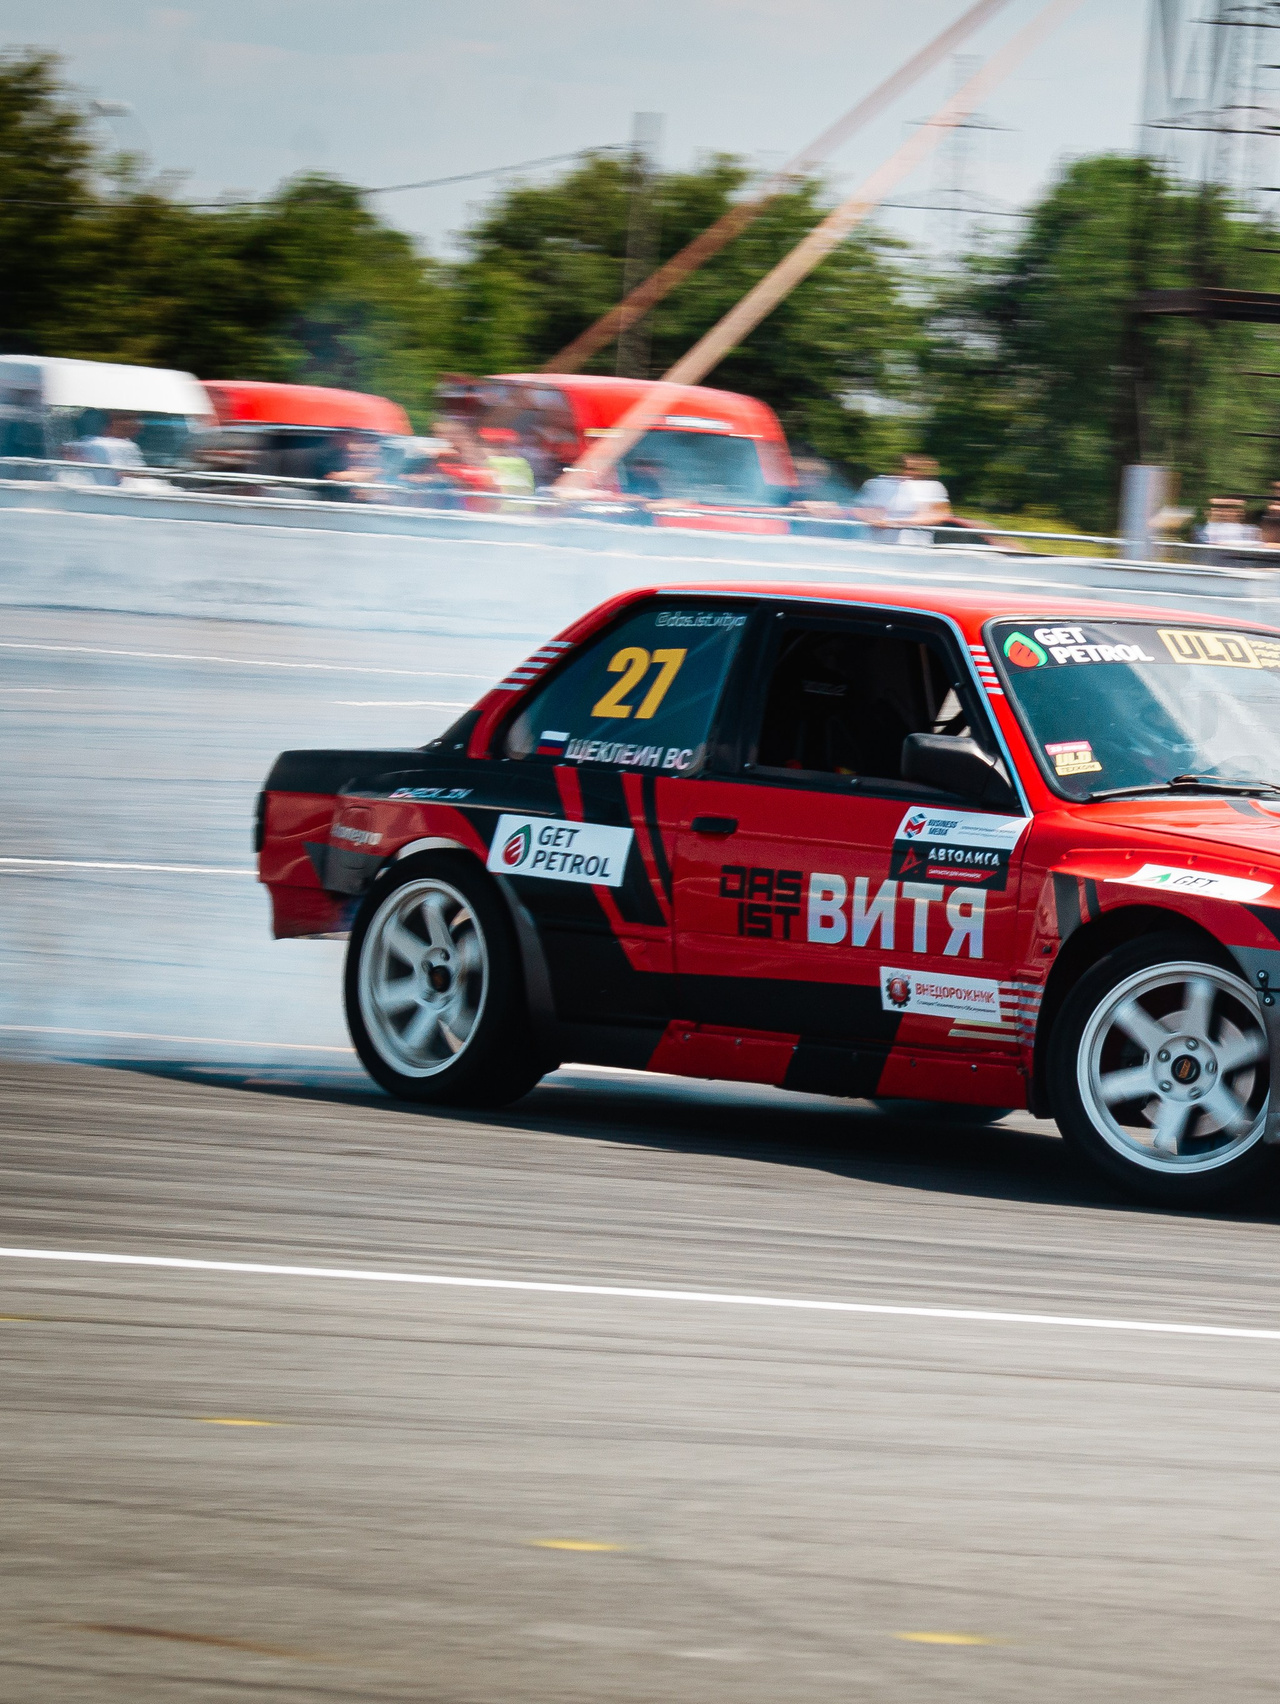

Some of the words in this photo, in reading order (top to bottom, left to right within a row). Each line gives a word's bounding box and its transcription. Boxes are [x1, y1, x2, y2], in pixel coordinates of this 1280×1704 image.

[1034, 627, 1087, 646] GET
[1165, 633, 1253, 664] ULD
[1049, 644, 1155, 664] PETROL
[590, 647, 688, 719] 27
[539, 826, 581, 848] GET
[530, 850, 612, 878] PETROL
[928, 848, 1000, 866] АВТОЛИГА
[719, 864, 803, 901] DAS
[738, 902, 800, 939] IST
[807, 872, 987, 959] ВИТЯ
[915, 983, 996, 1004] ВНЕДОРОЖНИК
